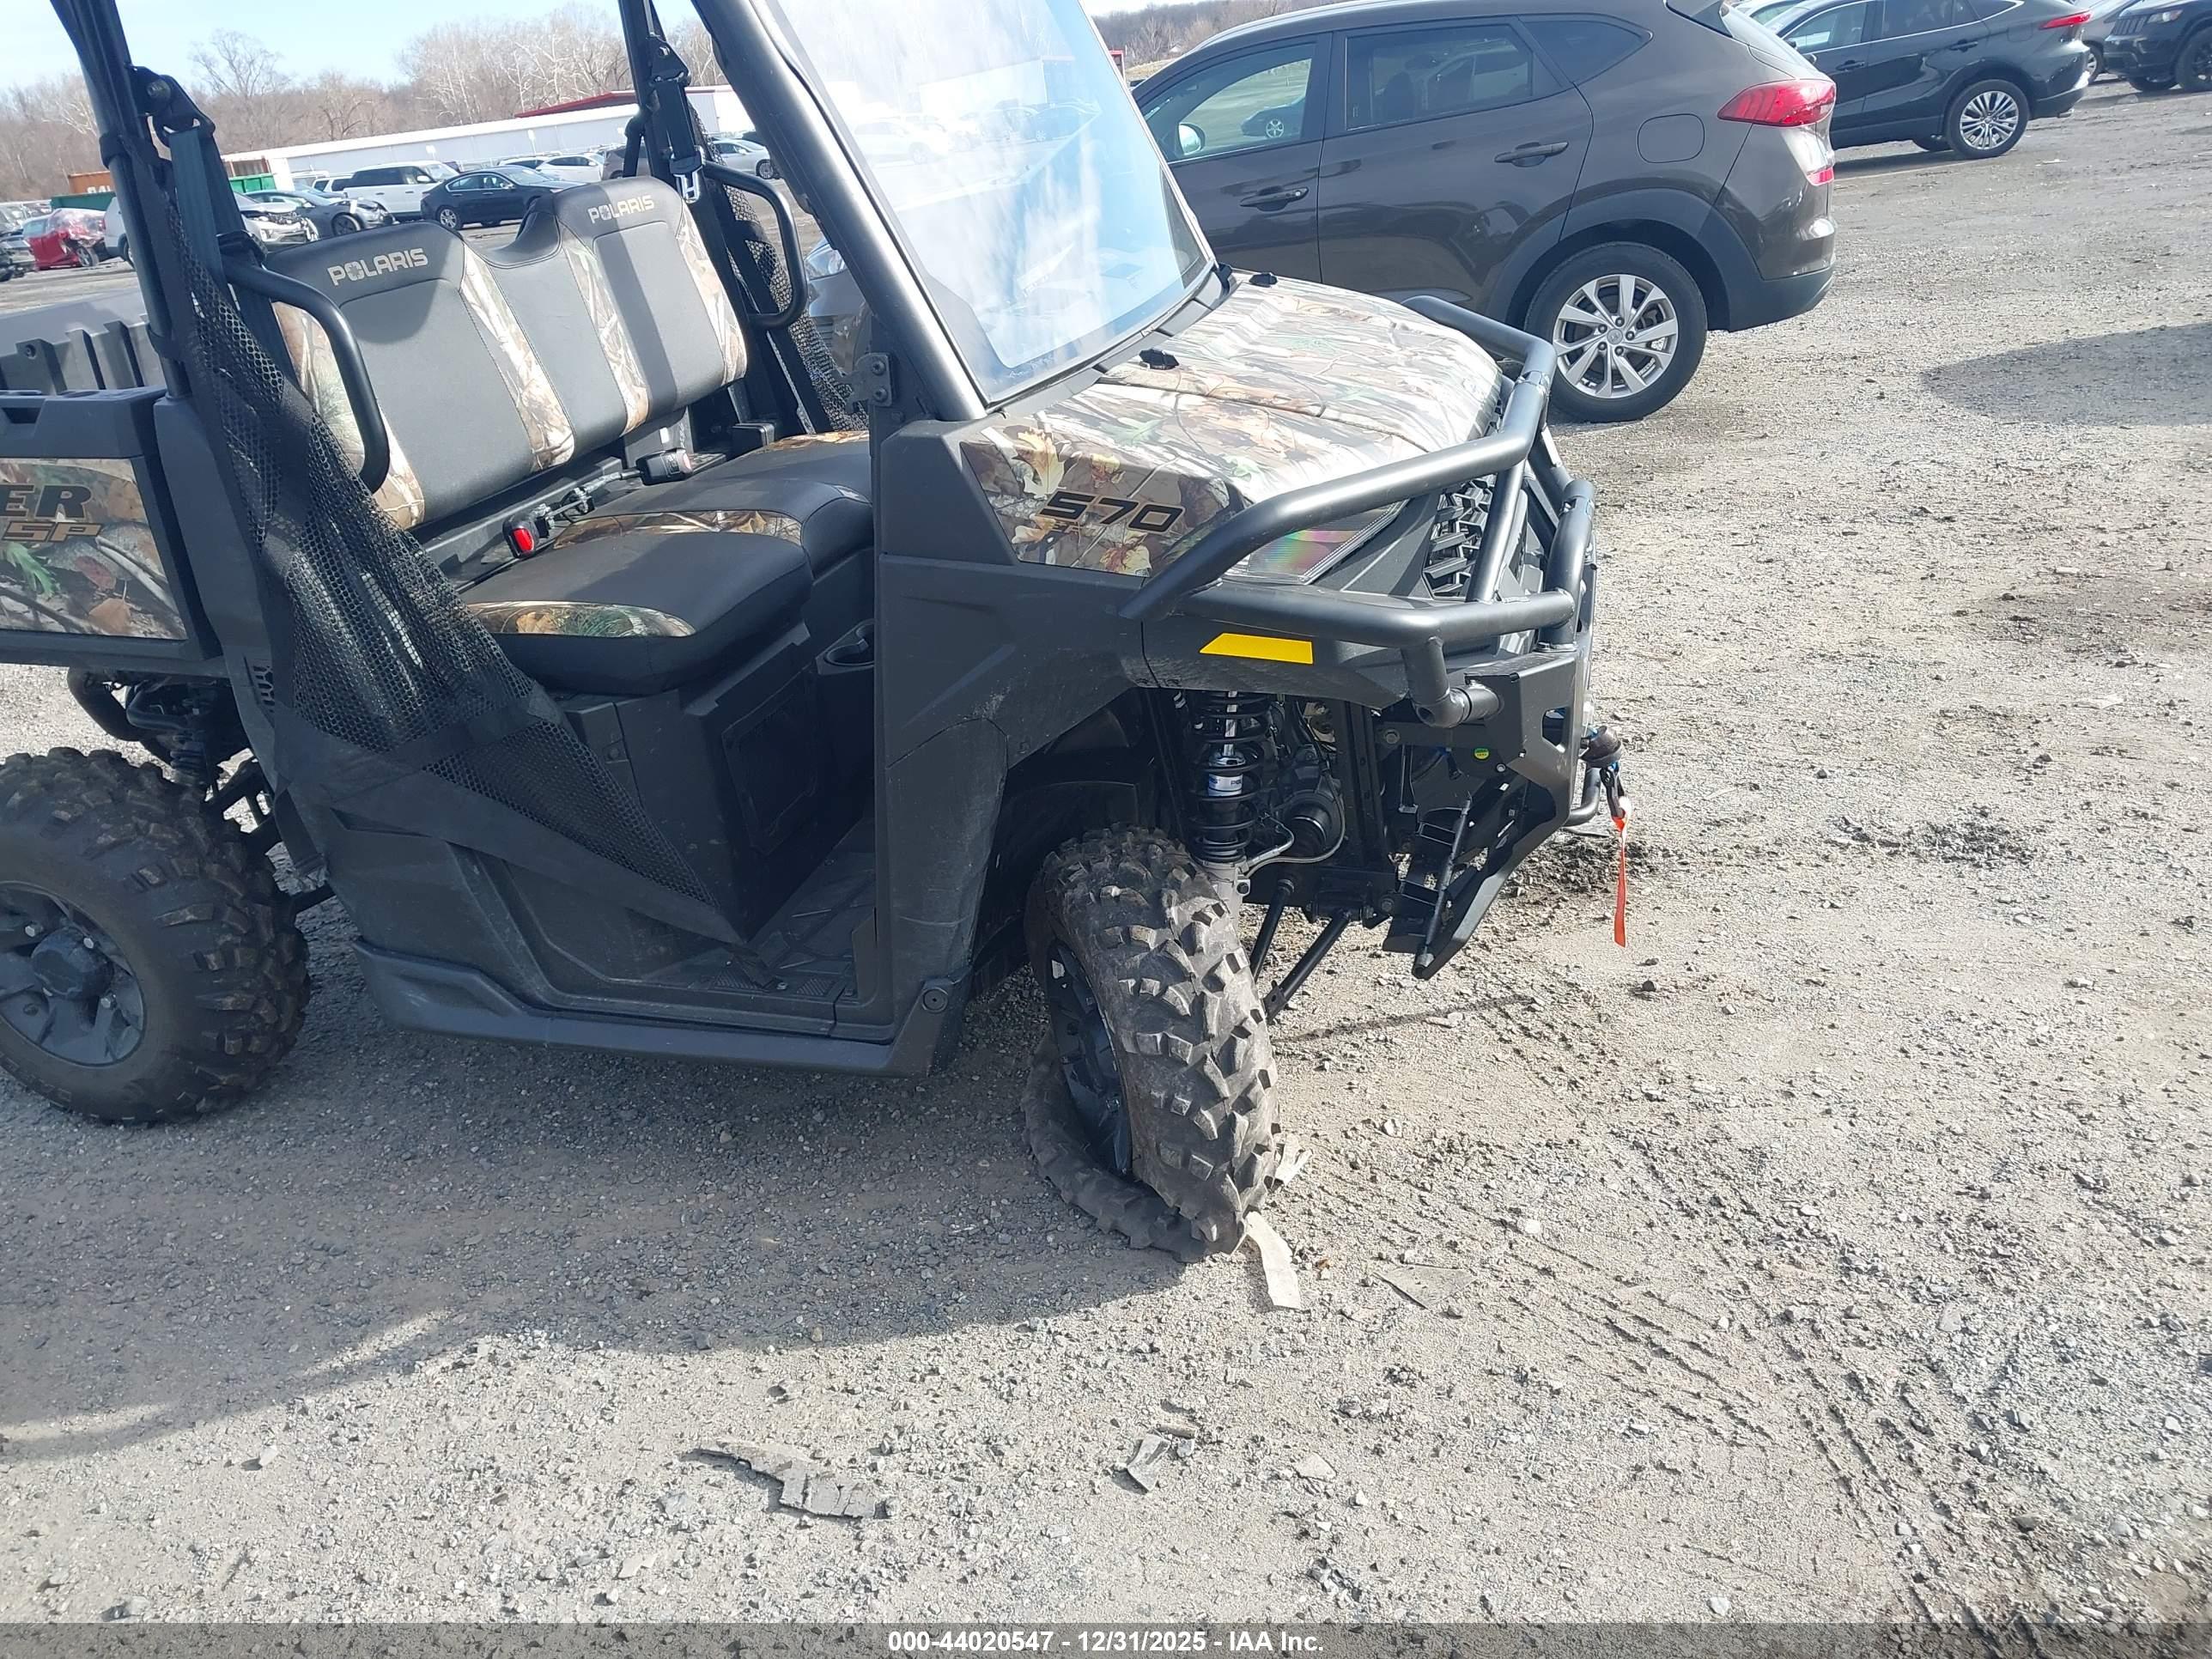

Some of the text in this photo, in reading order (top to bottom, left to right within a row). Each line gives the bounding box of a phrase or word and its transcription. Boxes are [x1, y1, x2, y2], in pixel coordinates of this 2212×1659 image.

[587, 195, 654, 223] POLARIS
[327, 247, 428, 286] POLARIS
[1038, 489, 1185, 533] 570
[2, 520, 102, 542] SP
